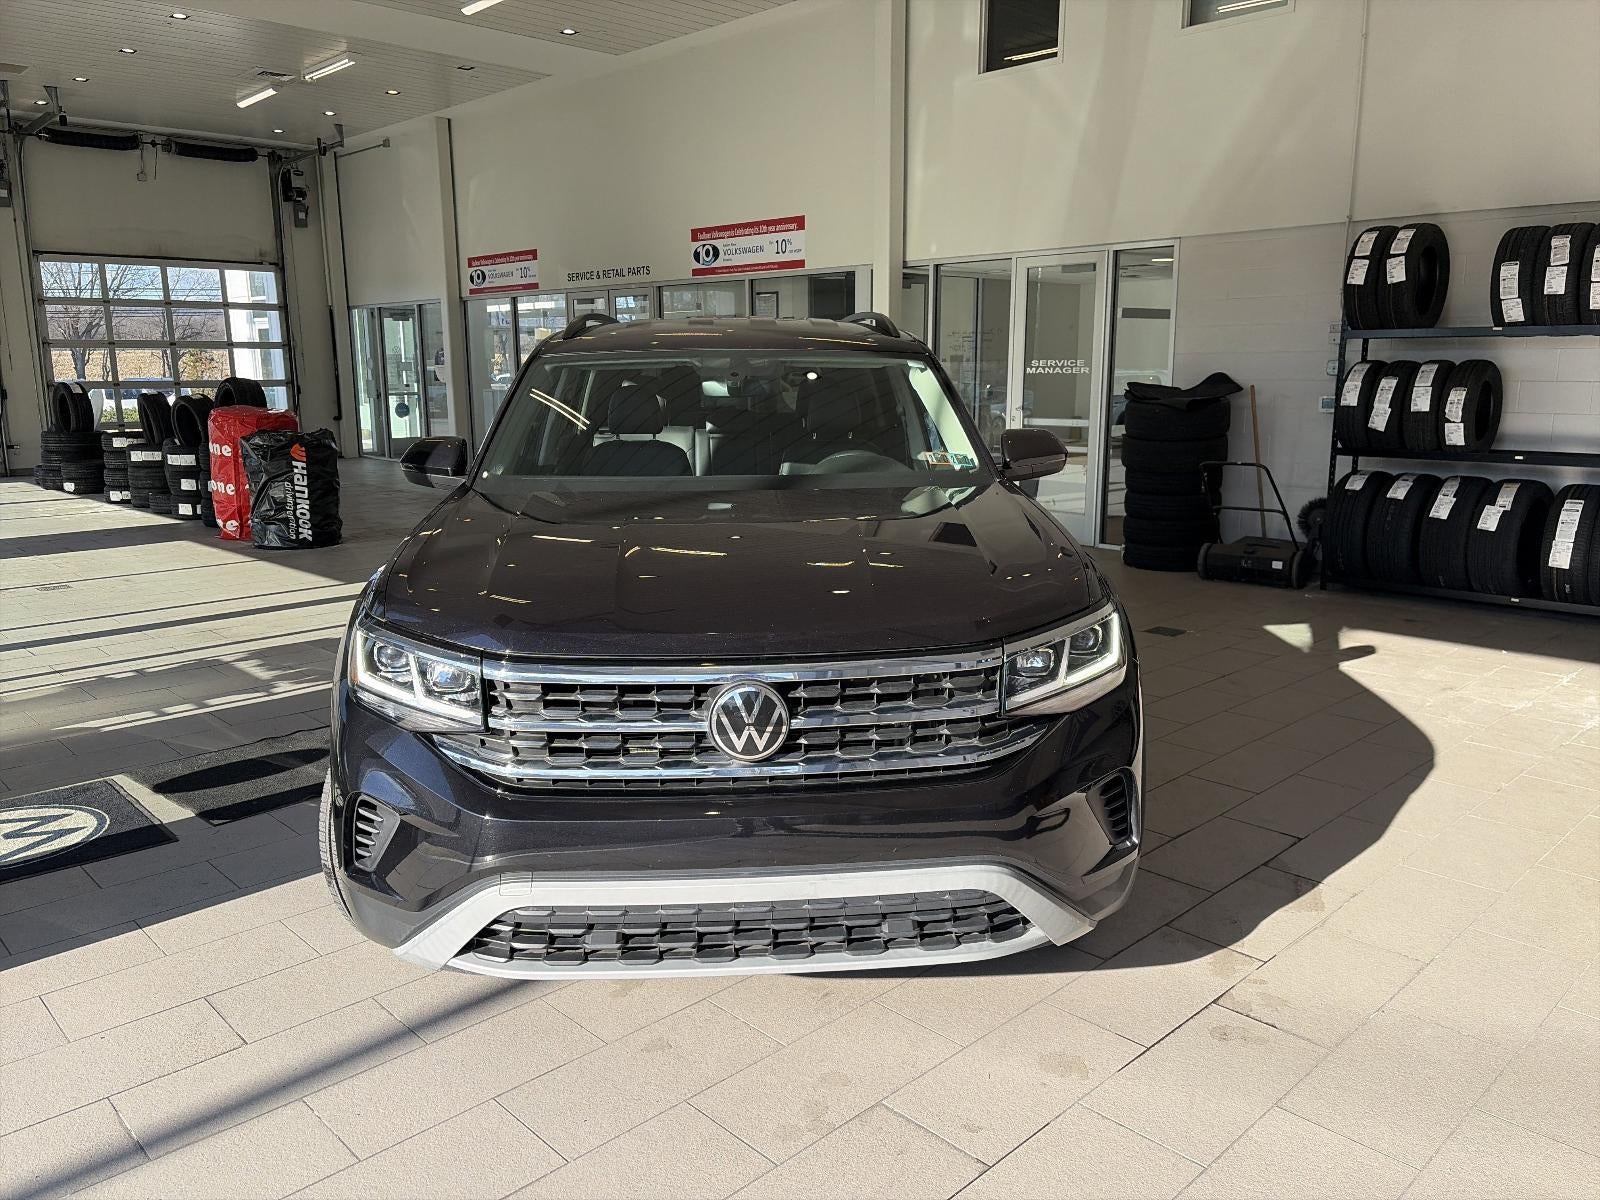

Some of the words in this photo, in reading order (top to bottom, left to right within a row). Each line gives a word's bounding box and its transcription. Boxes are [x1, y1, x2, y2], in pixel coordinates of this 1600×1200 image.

[722, 245, 764, 256] VOLKSWAGEN
[567, 271, 595, 282] SERVICE
[596, 270, 601, 280] &
[602, 268, 626, 279] RETAIL
[627, 265, 651, 277] PARTS
[1031, 359, 1085, 367] SERVICE
[1026, 366, 1090, 374] MANAGER
